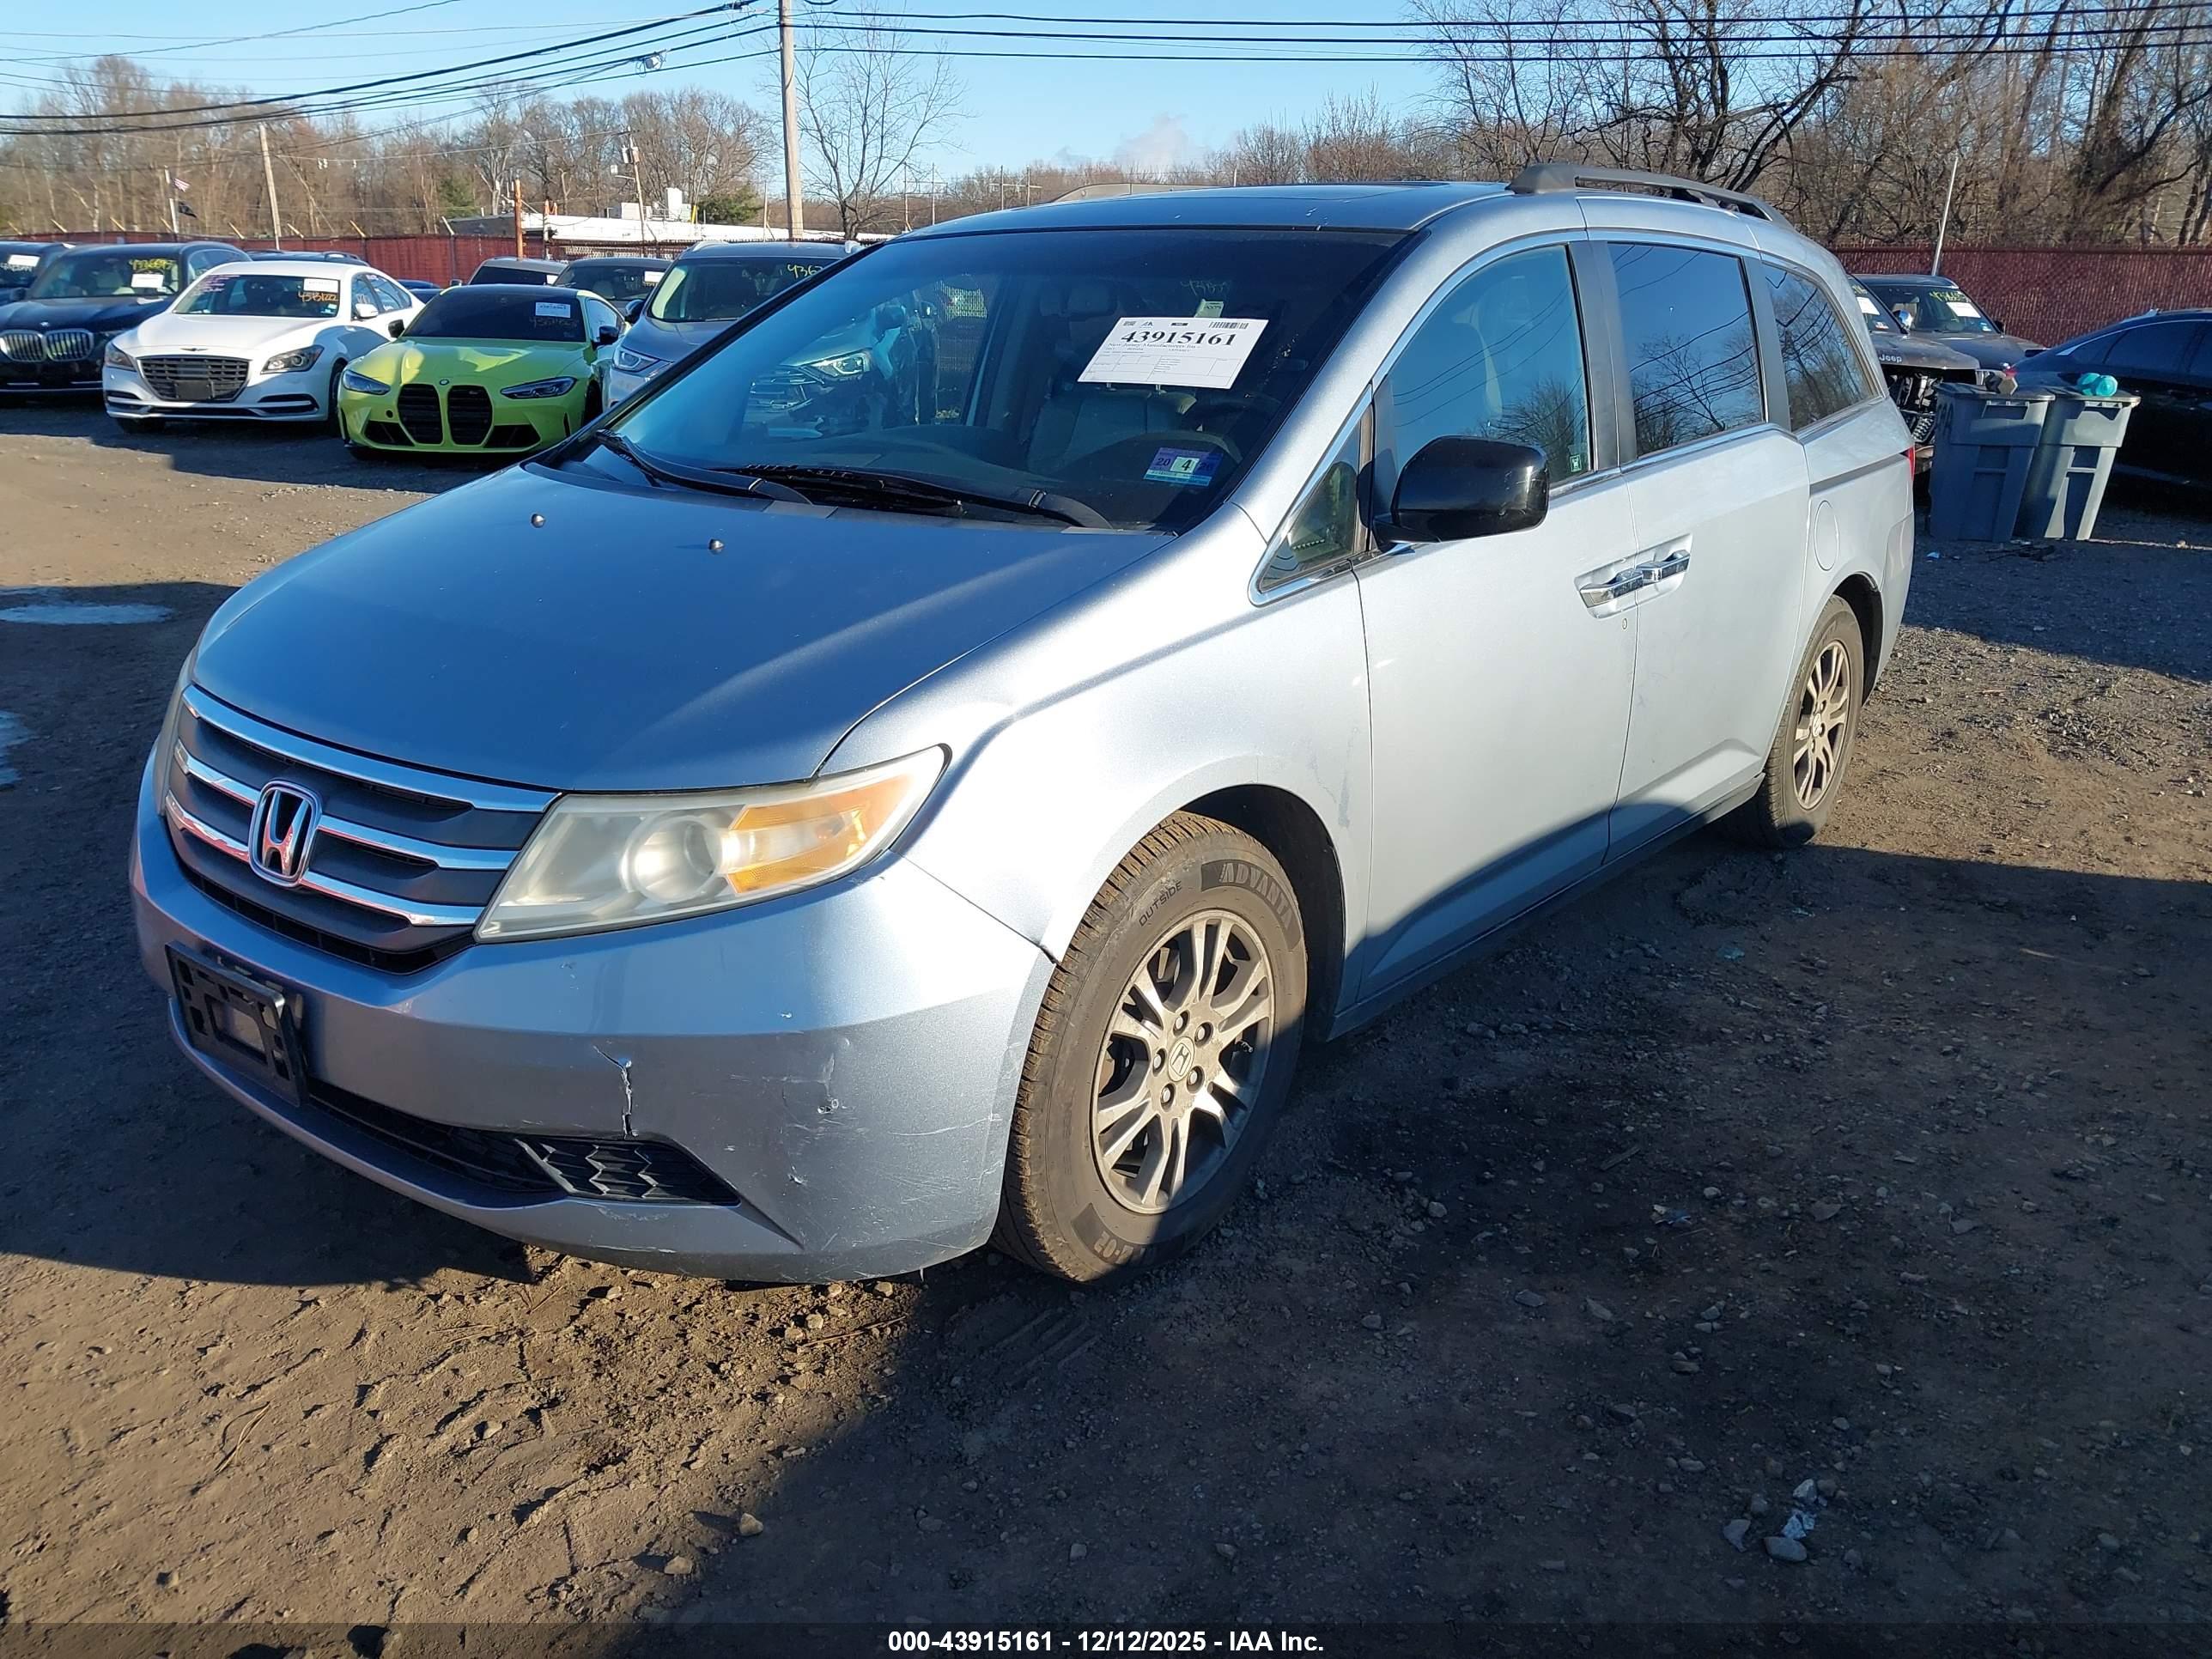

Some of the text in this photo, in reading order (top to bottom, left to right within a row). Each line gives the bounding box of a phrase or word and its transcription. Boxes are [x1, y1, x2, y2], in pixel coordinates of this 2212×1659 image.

[1121, 331, 1237, 346] 43915161
[1879, 354, 1902, 363] Jeep
[1155, 458, 1171, 466] 20
[1181, 459, 1193, 471] 4
[1219, 863, 1293, 928] ADVANTA
[1139, 880, 1182, 927] OUTSIDE
